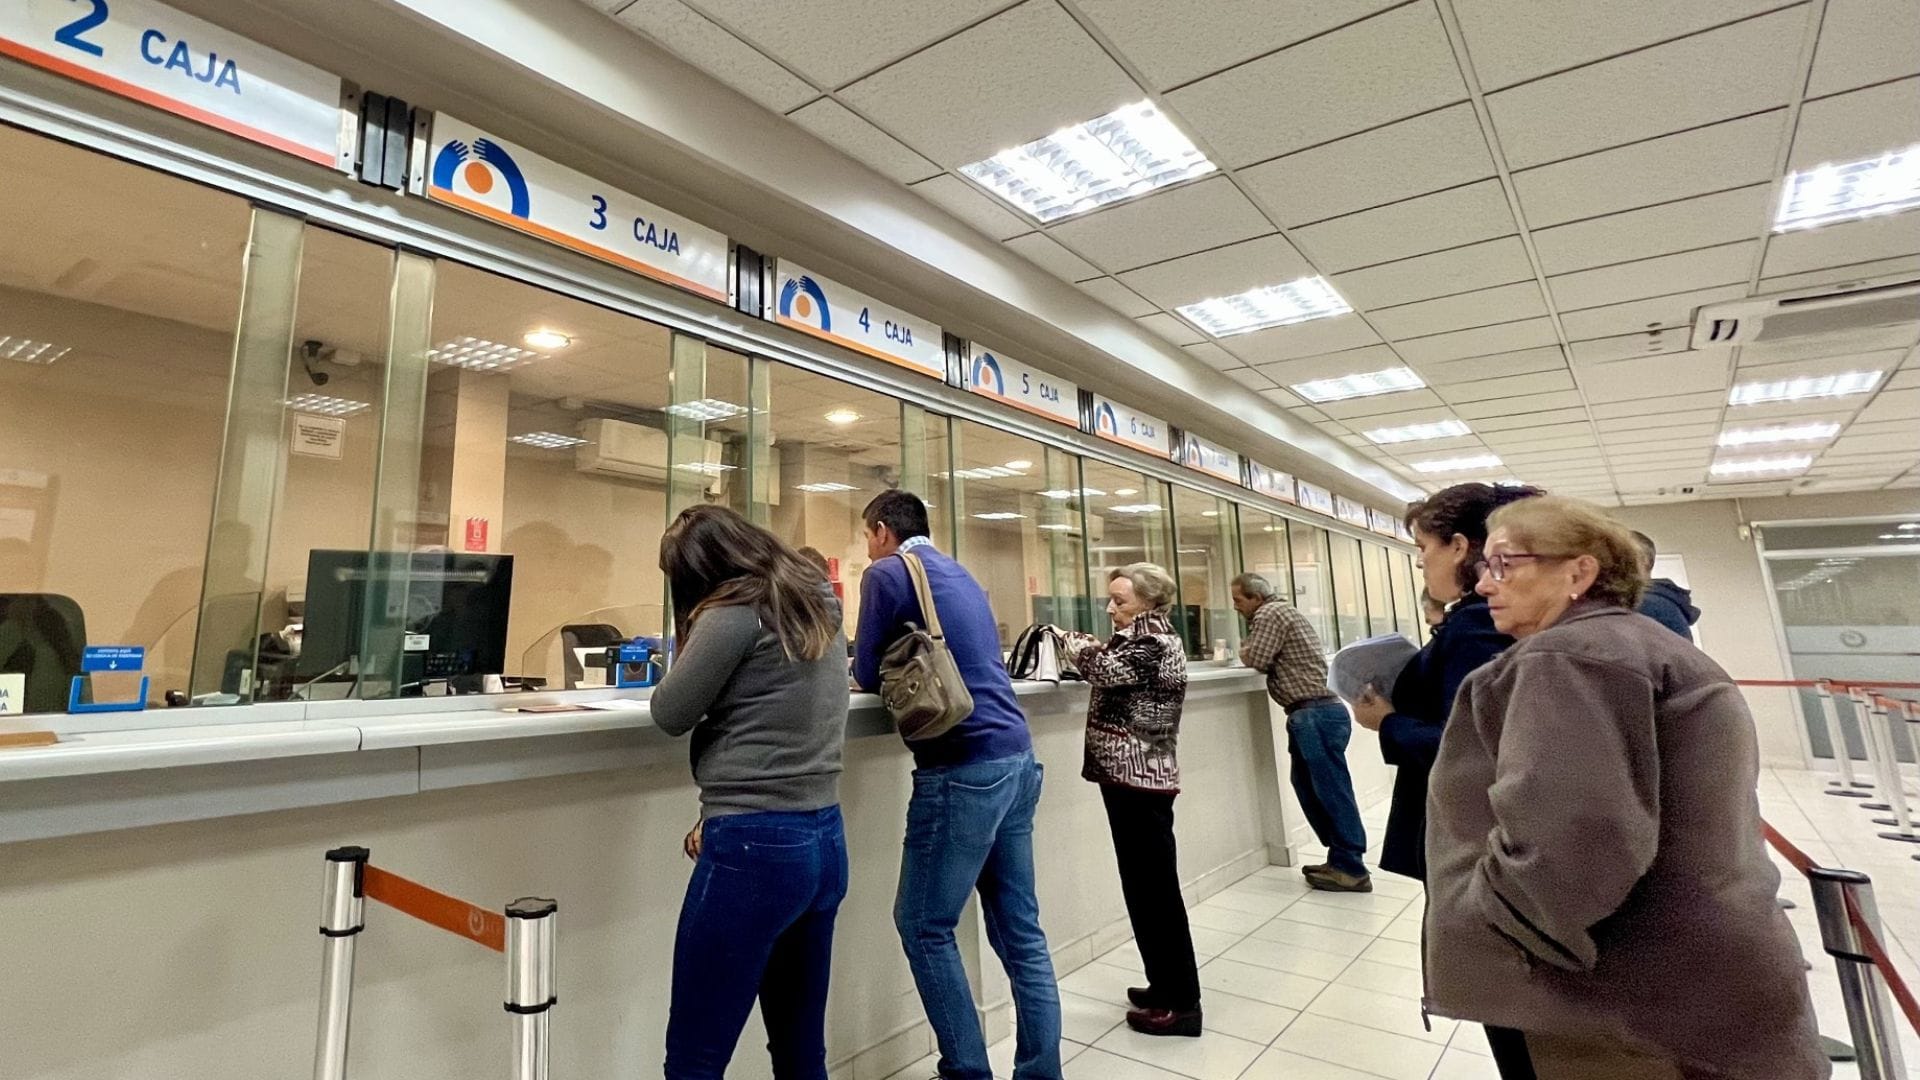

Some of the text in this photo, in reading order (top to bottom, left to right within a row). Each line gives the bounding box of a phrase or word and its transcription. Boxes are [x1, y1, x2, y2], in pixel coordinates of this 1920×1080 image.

[54, 0, 241, 95] 2 CAJA
[589, 194, 681, 256] 3 CAJA
[859, 307, 913, 346] 4 CAJA
[1022, 373, 1059, 402] 5 CAJA
[1131, 417, 1137, 434] 6
